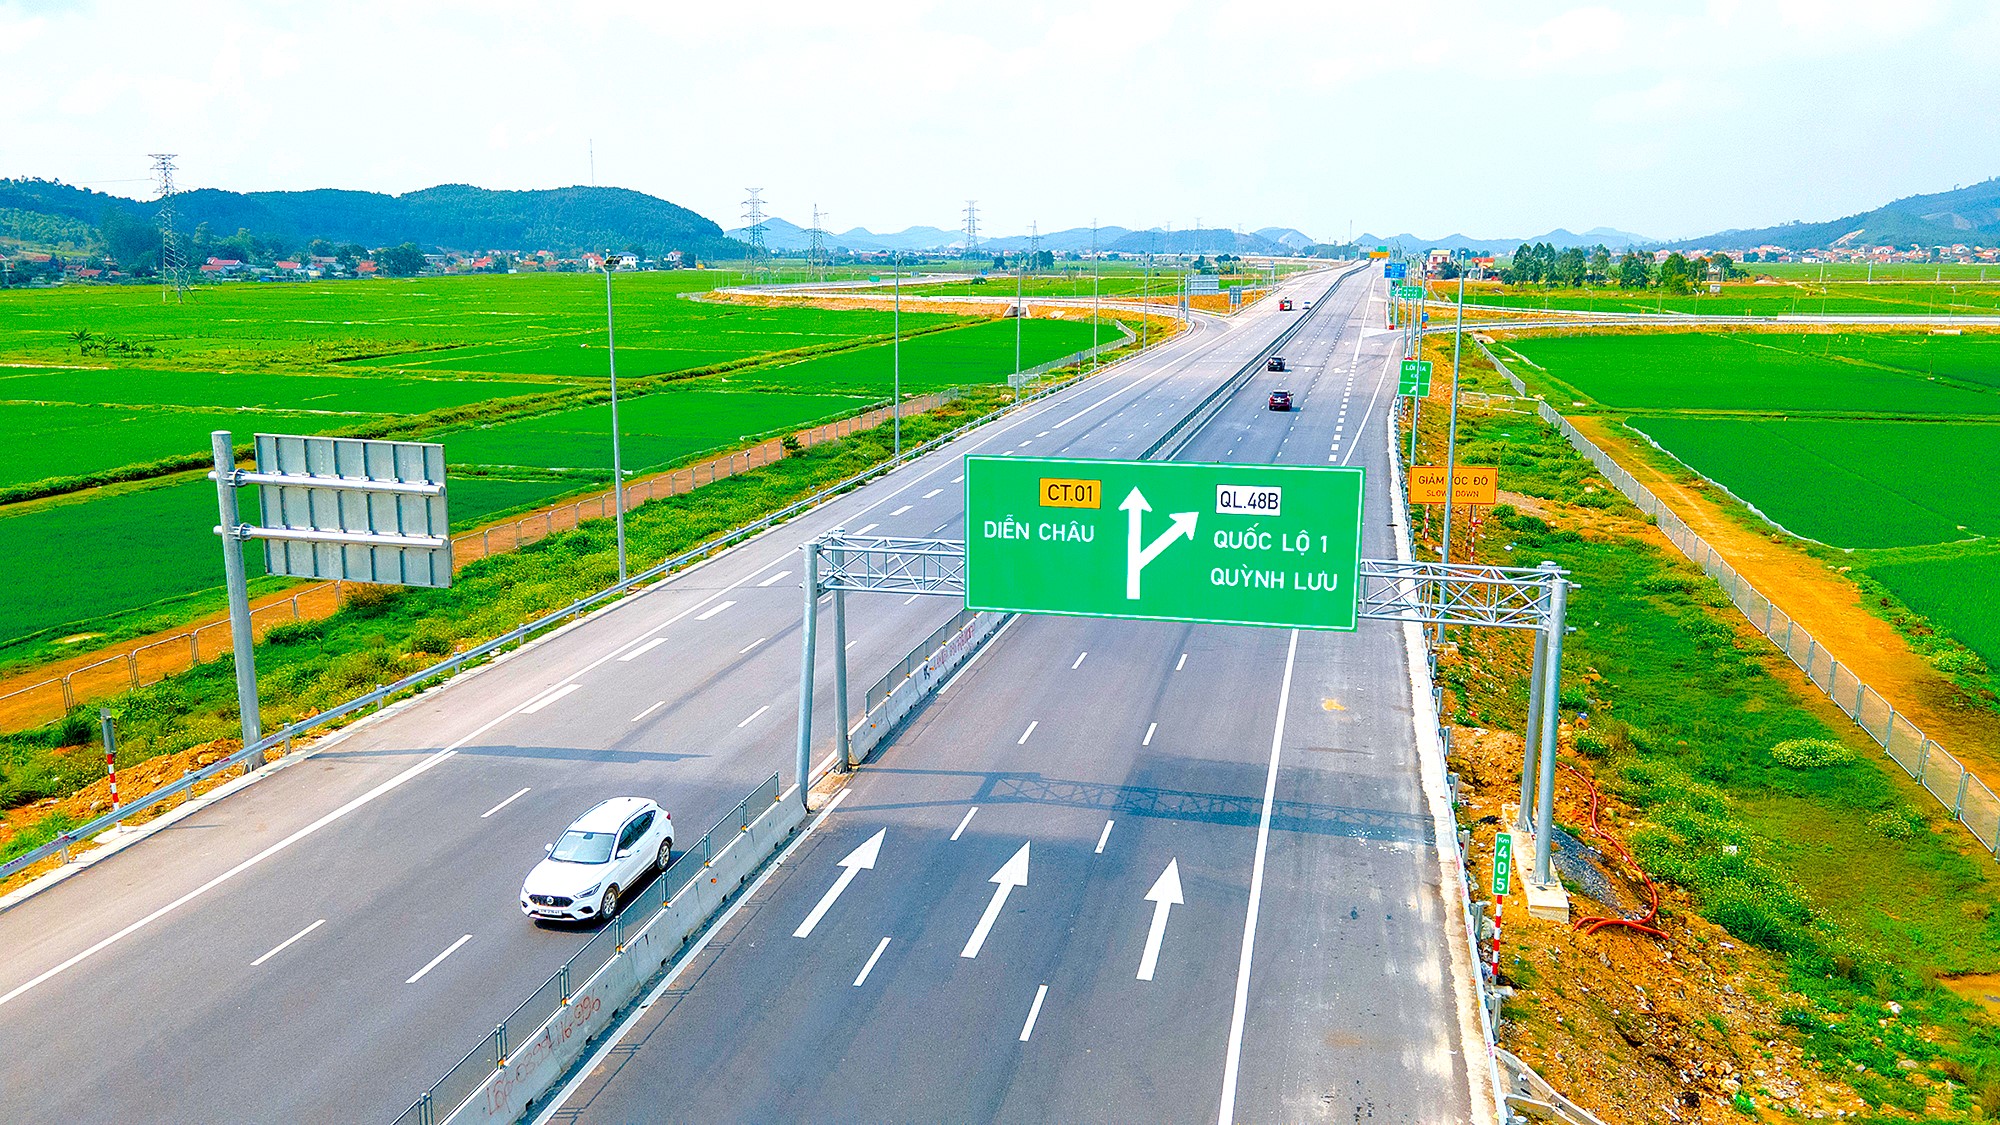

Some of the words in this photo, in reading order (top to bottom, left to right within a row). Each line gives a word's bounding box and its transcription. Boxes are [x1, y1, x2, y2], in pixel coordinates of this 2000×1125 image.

[1418, 472, 1445, 485] GIẢM
[1451, 472, 1468, 486] ỐC
[1048, 484, 1092, 502] CT.01
[1220, 490, 1279, 510] QL.48B
[1455, 490, 1479, 498] DOWN
[984, 514, 1030, 540] DIỄN
[1038, 520, 1095, 543] CHÂU
[1213, 522, 1272, 550] QUỐC
[1282, 529, 1311, 556] LỘ
[1320, 535, 1328, 553] 1
[1210, 563, 1285, 589] QUỲNH
[1294, 570, 1338, 592] LƯU
[1498, 836, 1510, 844] Km
[1495, 845, 1508, 892] 405
